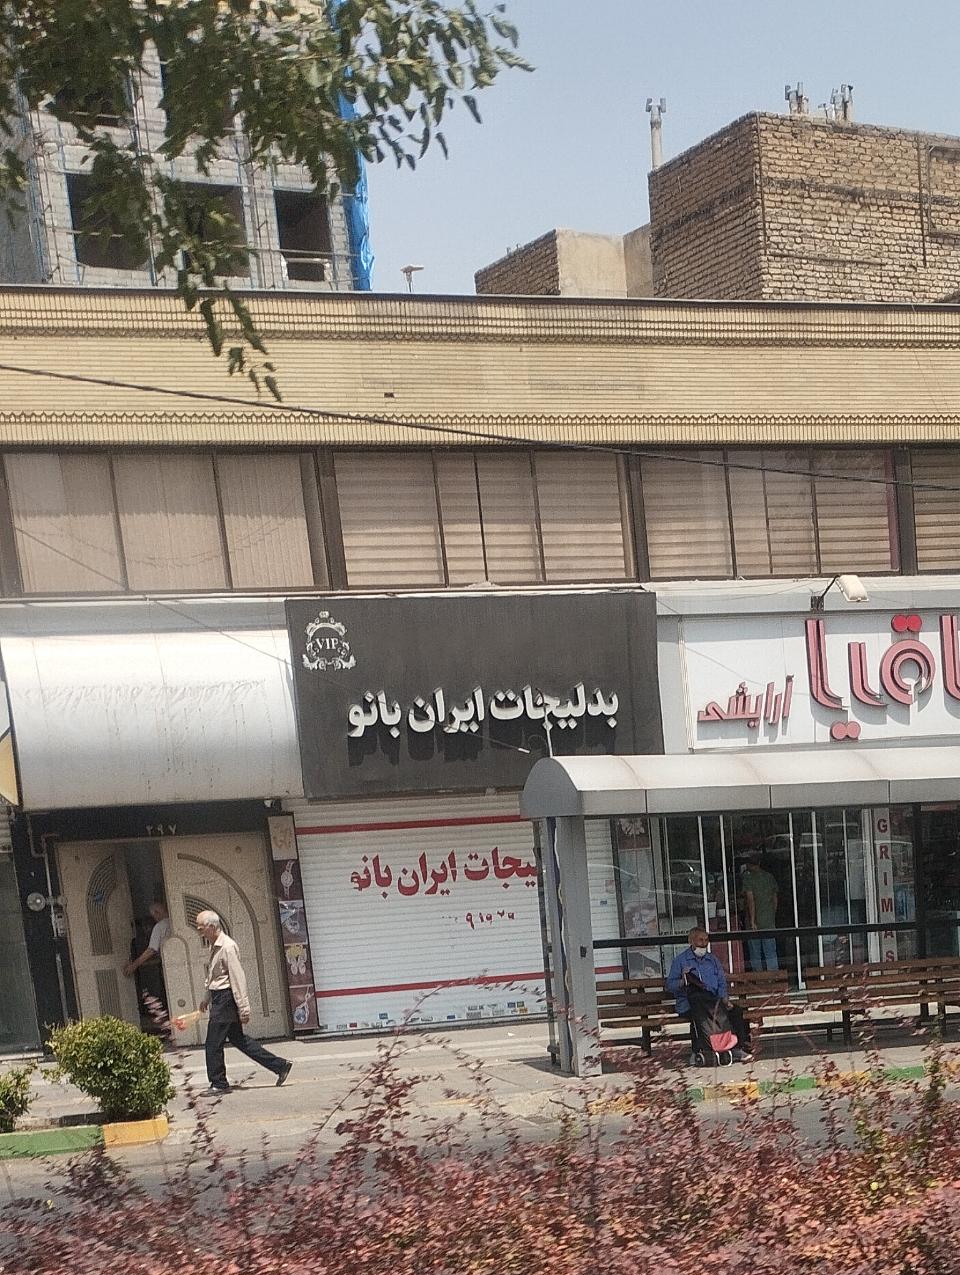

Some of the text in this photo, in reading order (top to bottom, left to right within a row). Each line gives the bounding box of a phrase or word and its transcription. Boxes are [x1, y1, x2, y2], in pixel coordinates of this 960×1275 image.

[315, 637, 339, 650] VIP
[348, 681, 619, 738] بدلیجات ایران بانو
[350, 853, 393, 899] بانو
[397, 850, 458, 896] ایران
